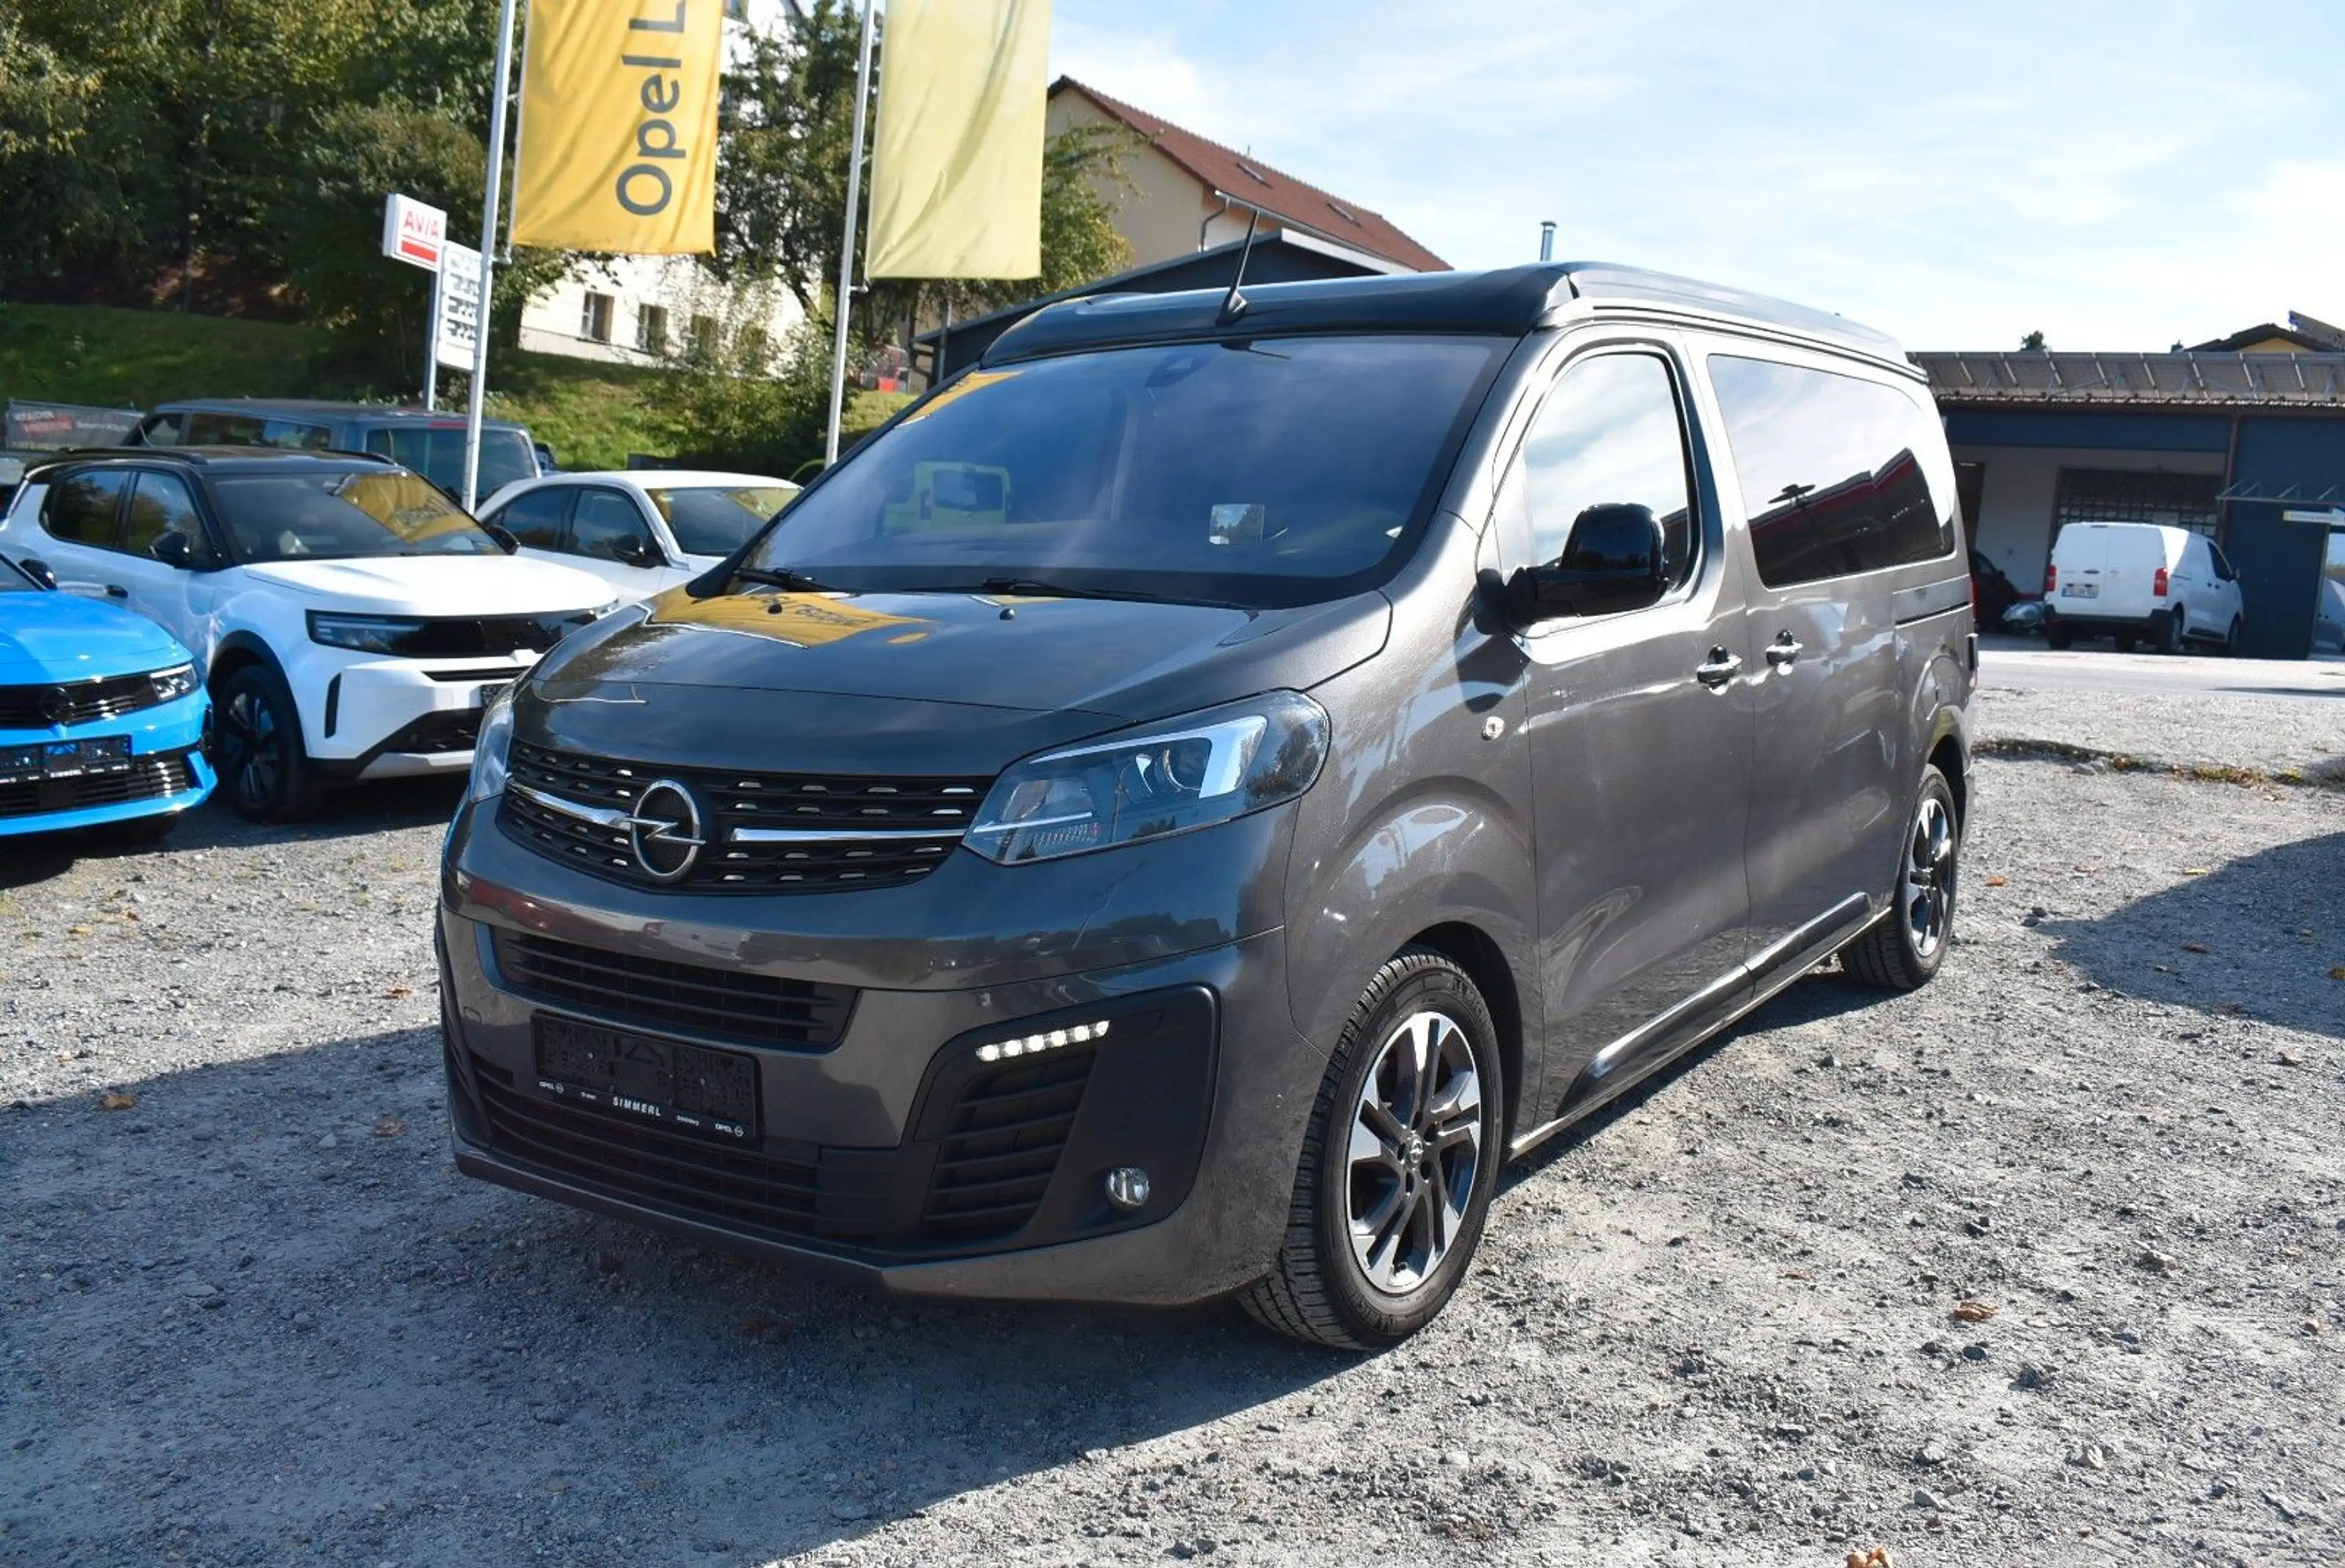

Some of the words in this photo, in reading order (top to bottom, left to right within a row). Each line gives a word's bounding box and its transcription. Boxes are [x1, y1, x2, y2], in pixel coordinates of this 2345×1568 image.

[616, 54, 686, 216] Opel
[403, 211, 439, 238] AVIA
[613, 1096, 661, 1117] SIMMERL
